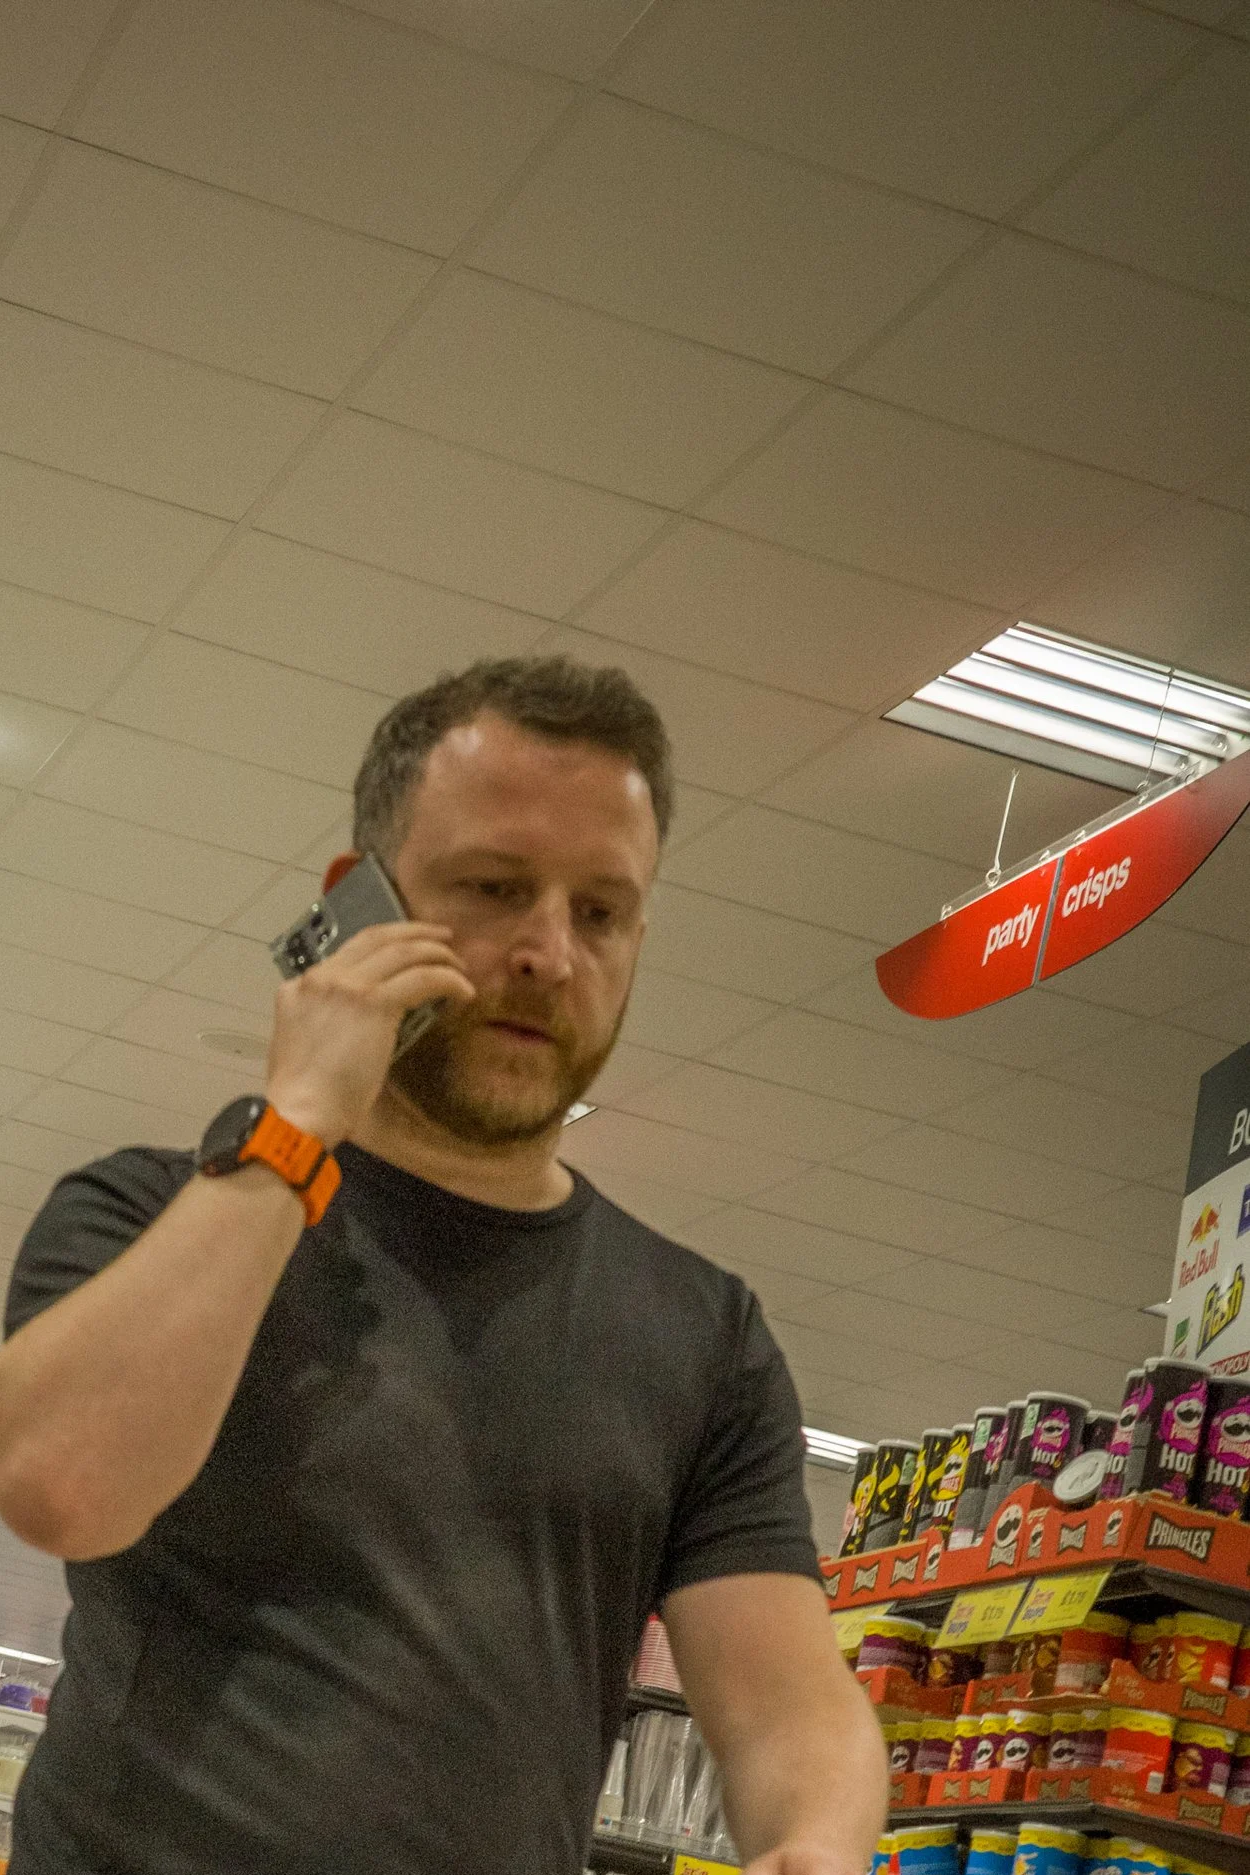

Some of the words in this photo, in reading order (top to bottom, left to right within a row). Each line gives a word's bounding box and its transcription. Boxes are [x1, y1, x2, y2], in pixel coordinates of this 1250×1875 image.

[981, 903, 1042, 967] party
[1061, 856, 1132, 918] crisps
[1205, 1457, 1249, 1488] HOT
[1150, 1516, 1213, 1559] PRINGLES
